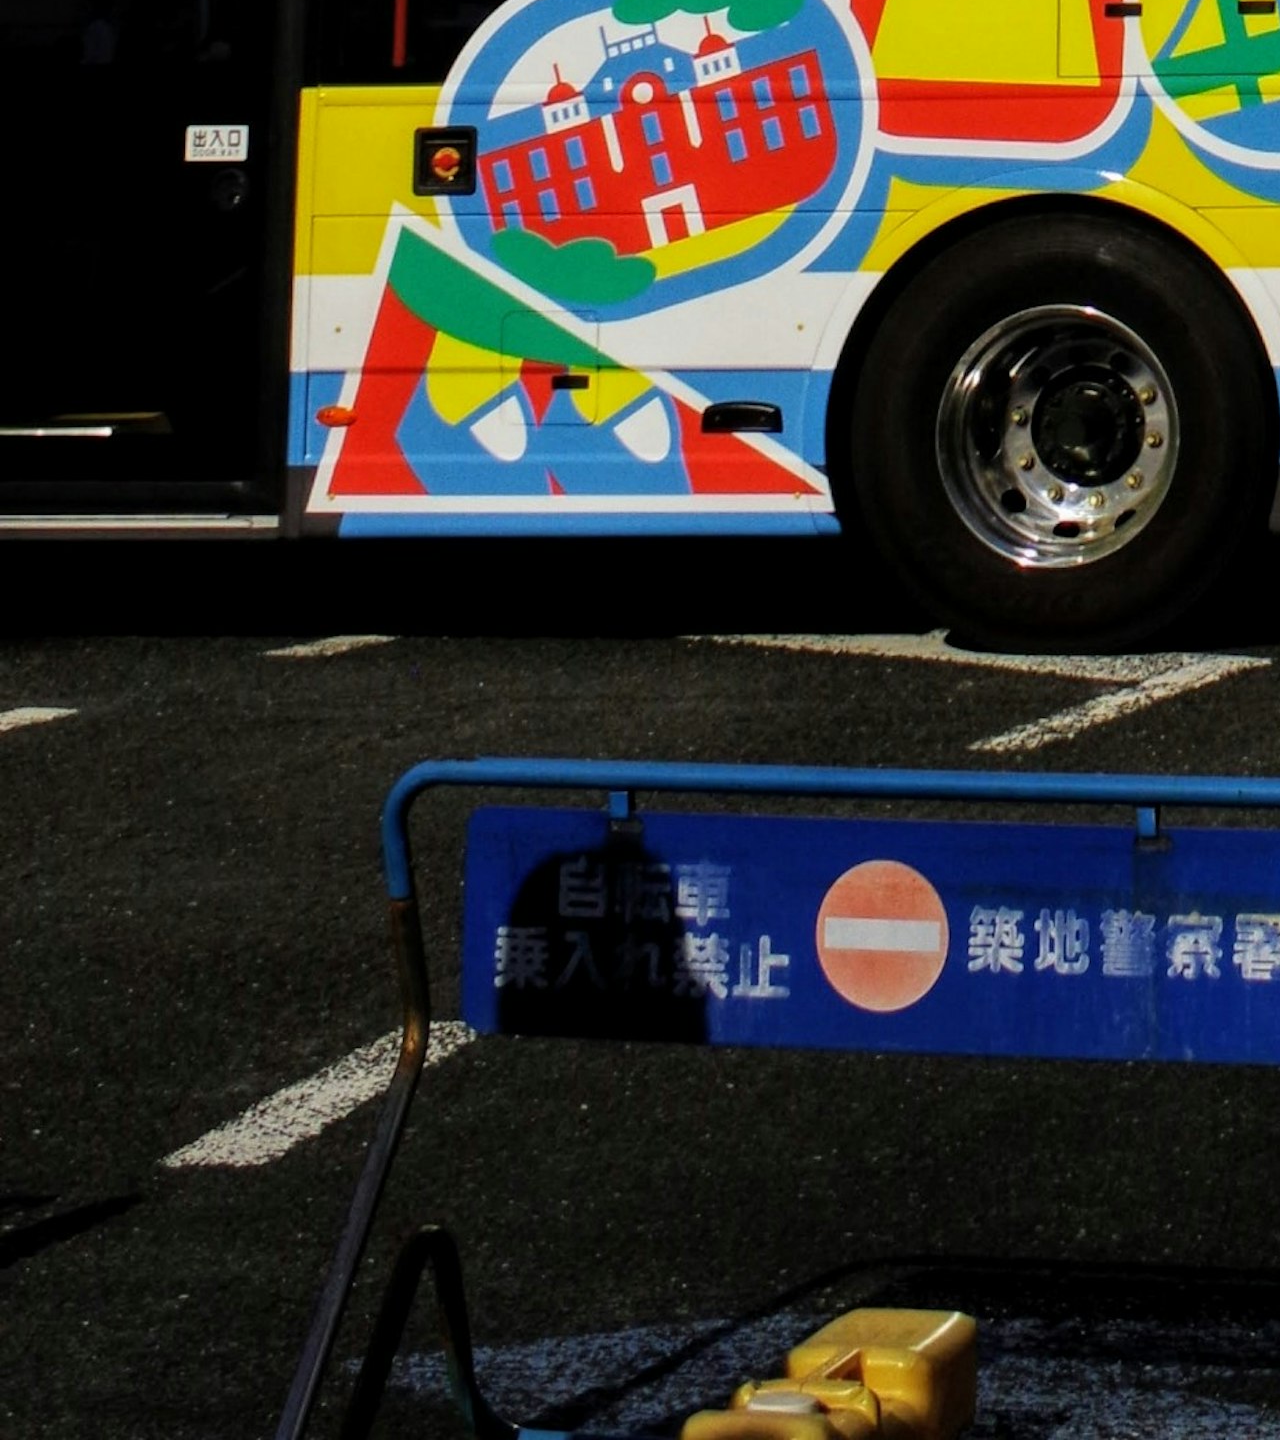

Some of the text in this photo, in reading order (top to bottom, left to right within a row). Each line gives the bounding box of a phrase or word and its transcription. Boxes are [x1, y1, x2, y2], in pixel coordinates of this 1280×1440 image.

[192, 129, 241, 148] 出入口
[559, 855, 732, 926] 自転車
[491, 926, 791, 1000] 乗入れ禁止
